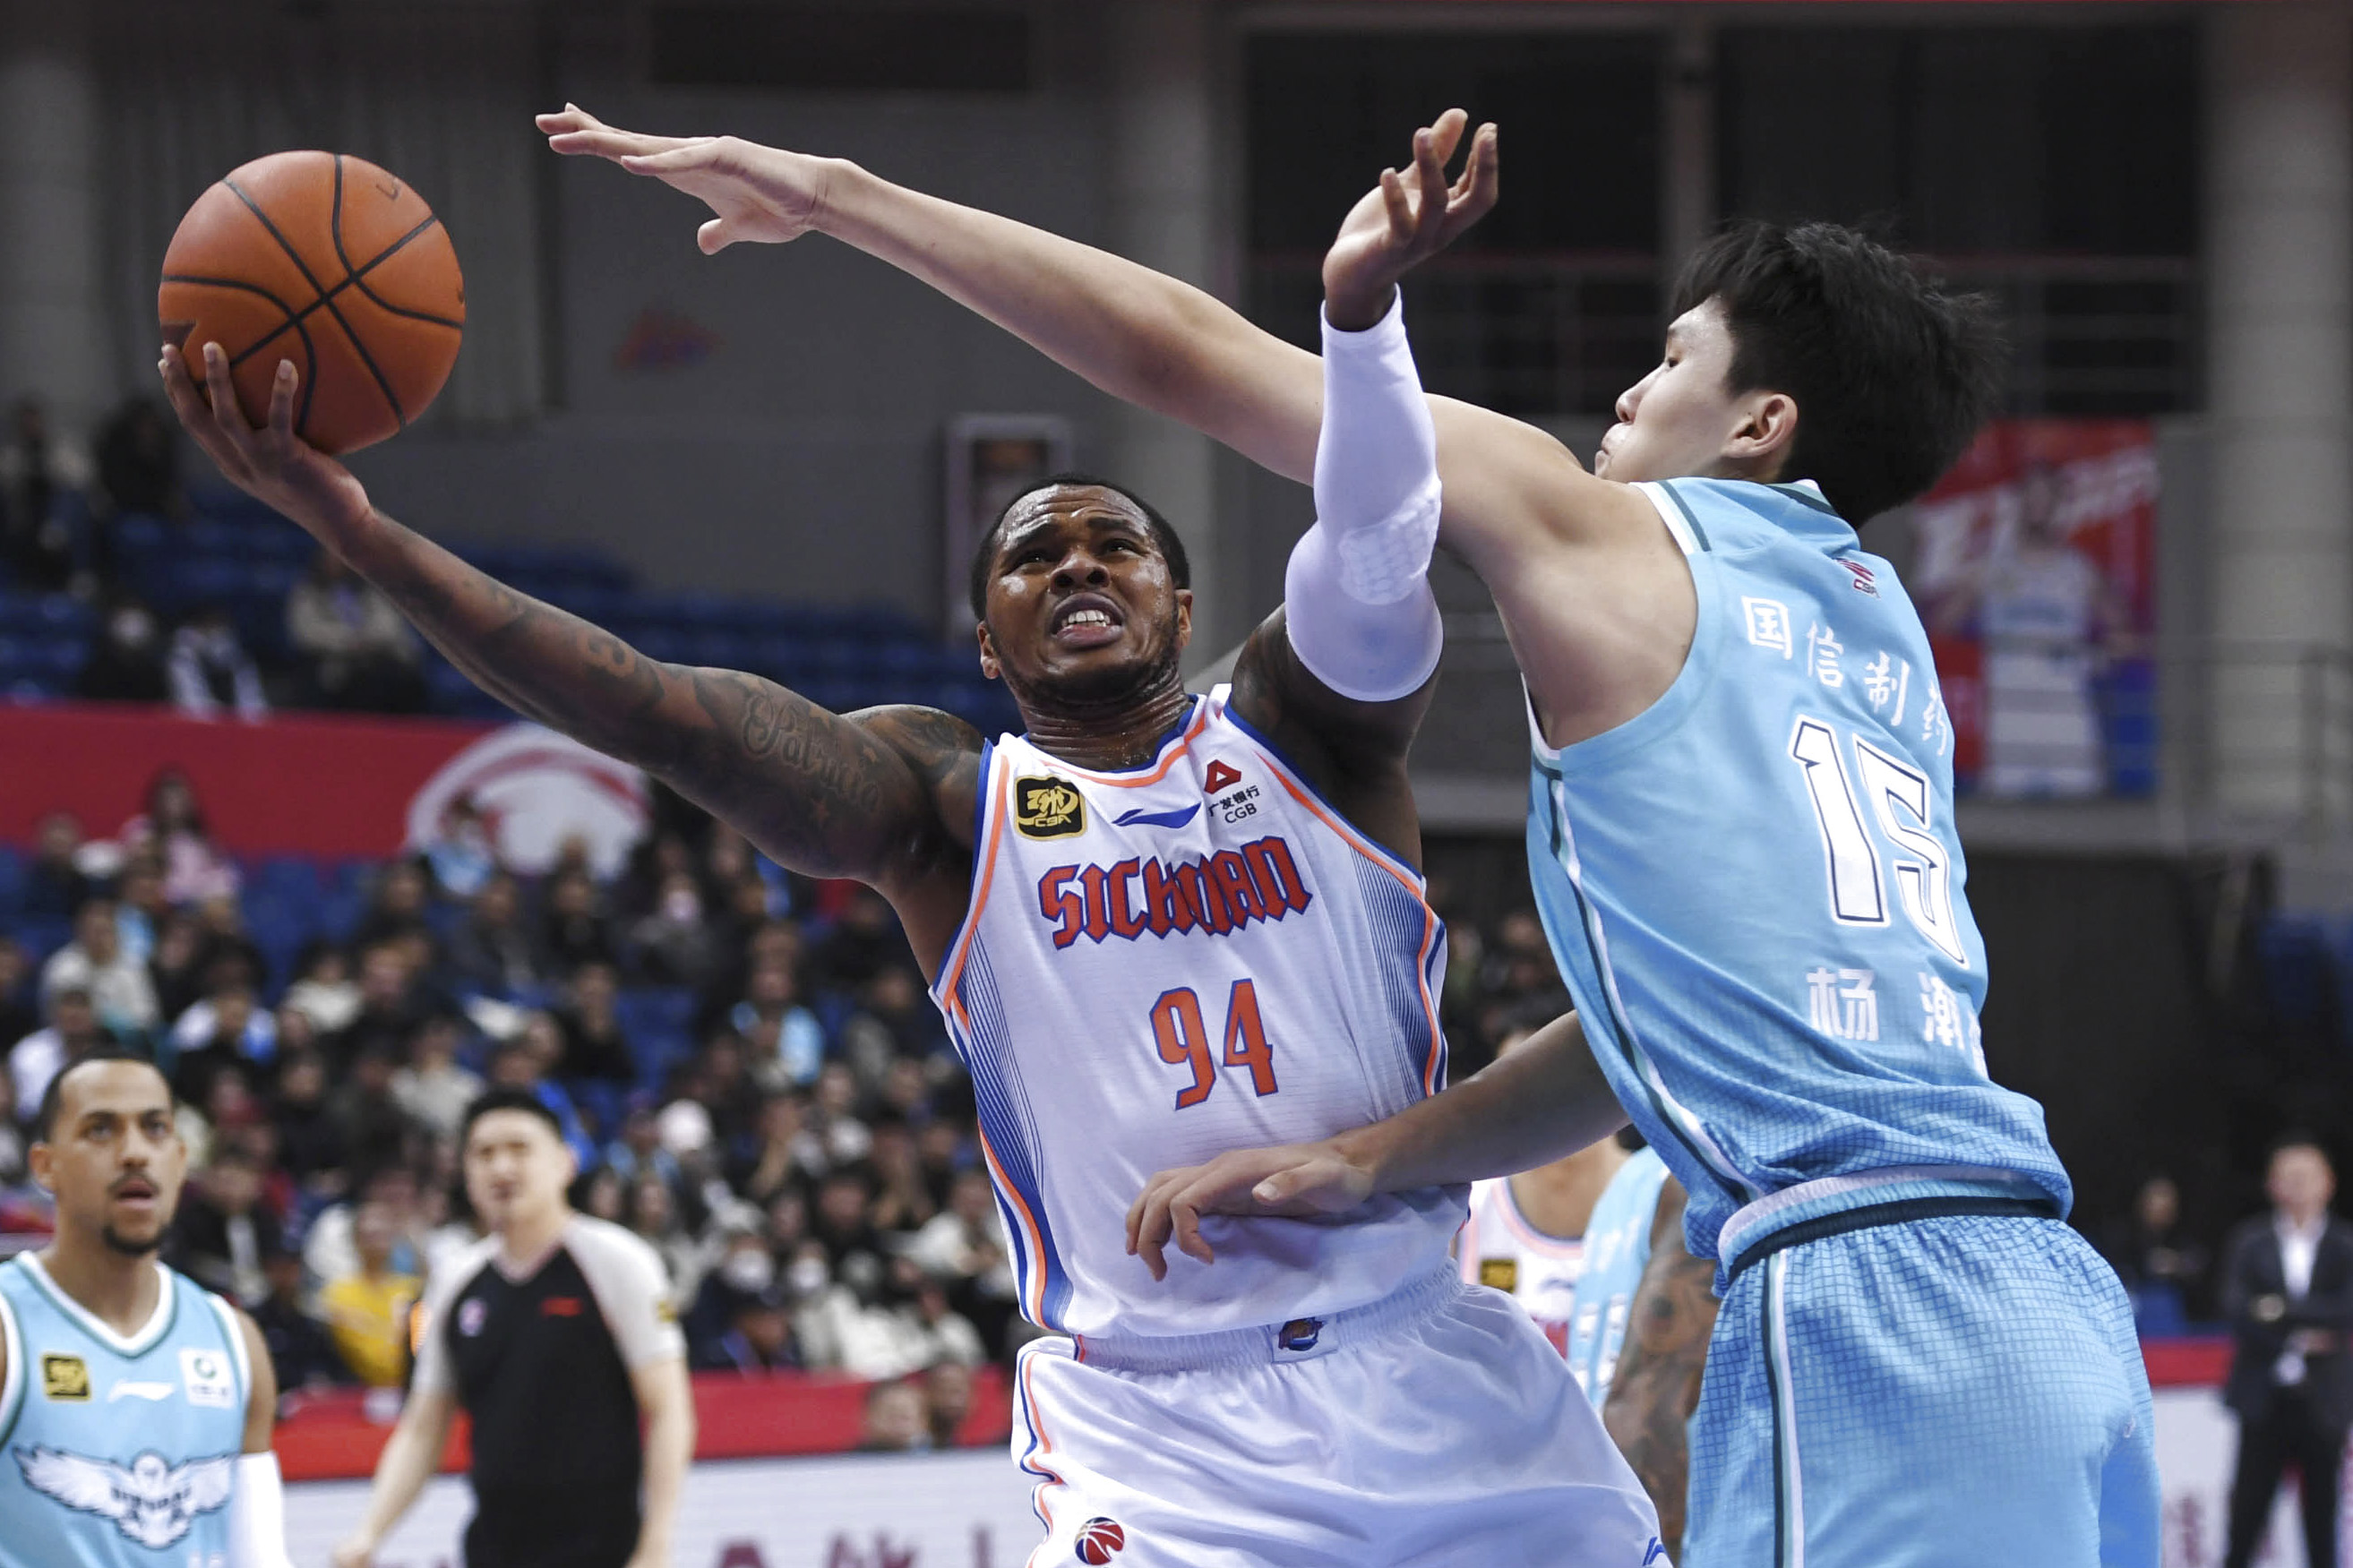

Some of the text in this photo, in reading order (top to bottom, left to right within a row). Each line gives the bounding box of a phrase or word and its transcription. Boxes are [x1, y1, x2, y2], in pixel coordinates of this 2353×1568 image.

[1741, 595, 1949, 756] 国信制药
[1207, 784, 1260, 817] 广发银行
[1224, 802, 1258, 824] CGB
[1788, 714, 1970, 970] 15
[1037, 835, 1313, 950] SICHUAN
[1148, 978, 1279, 1110] 94
